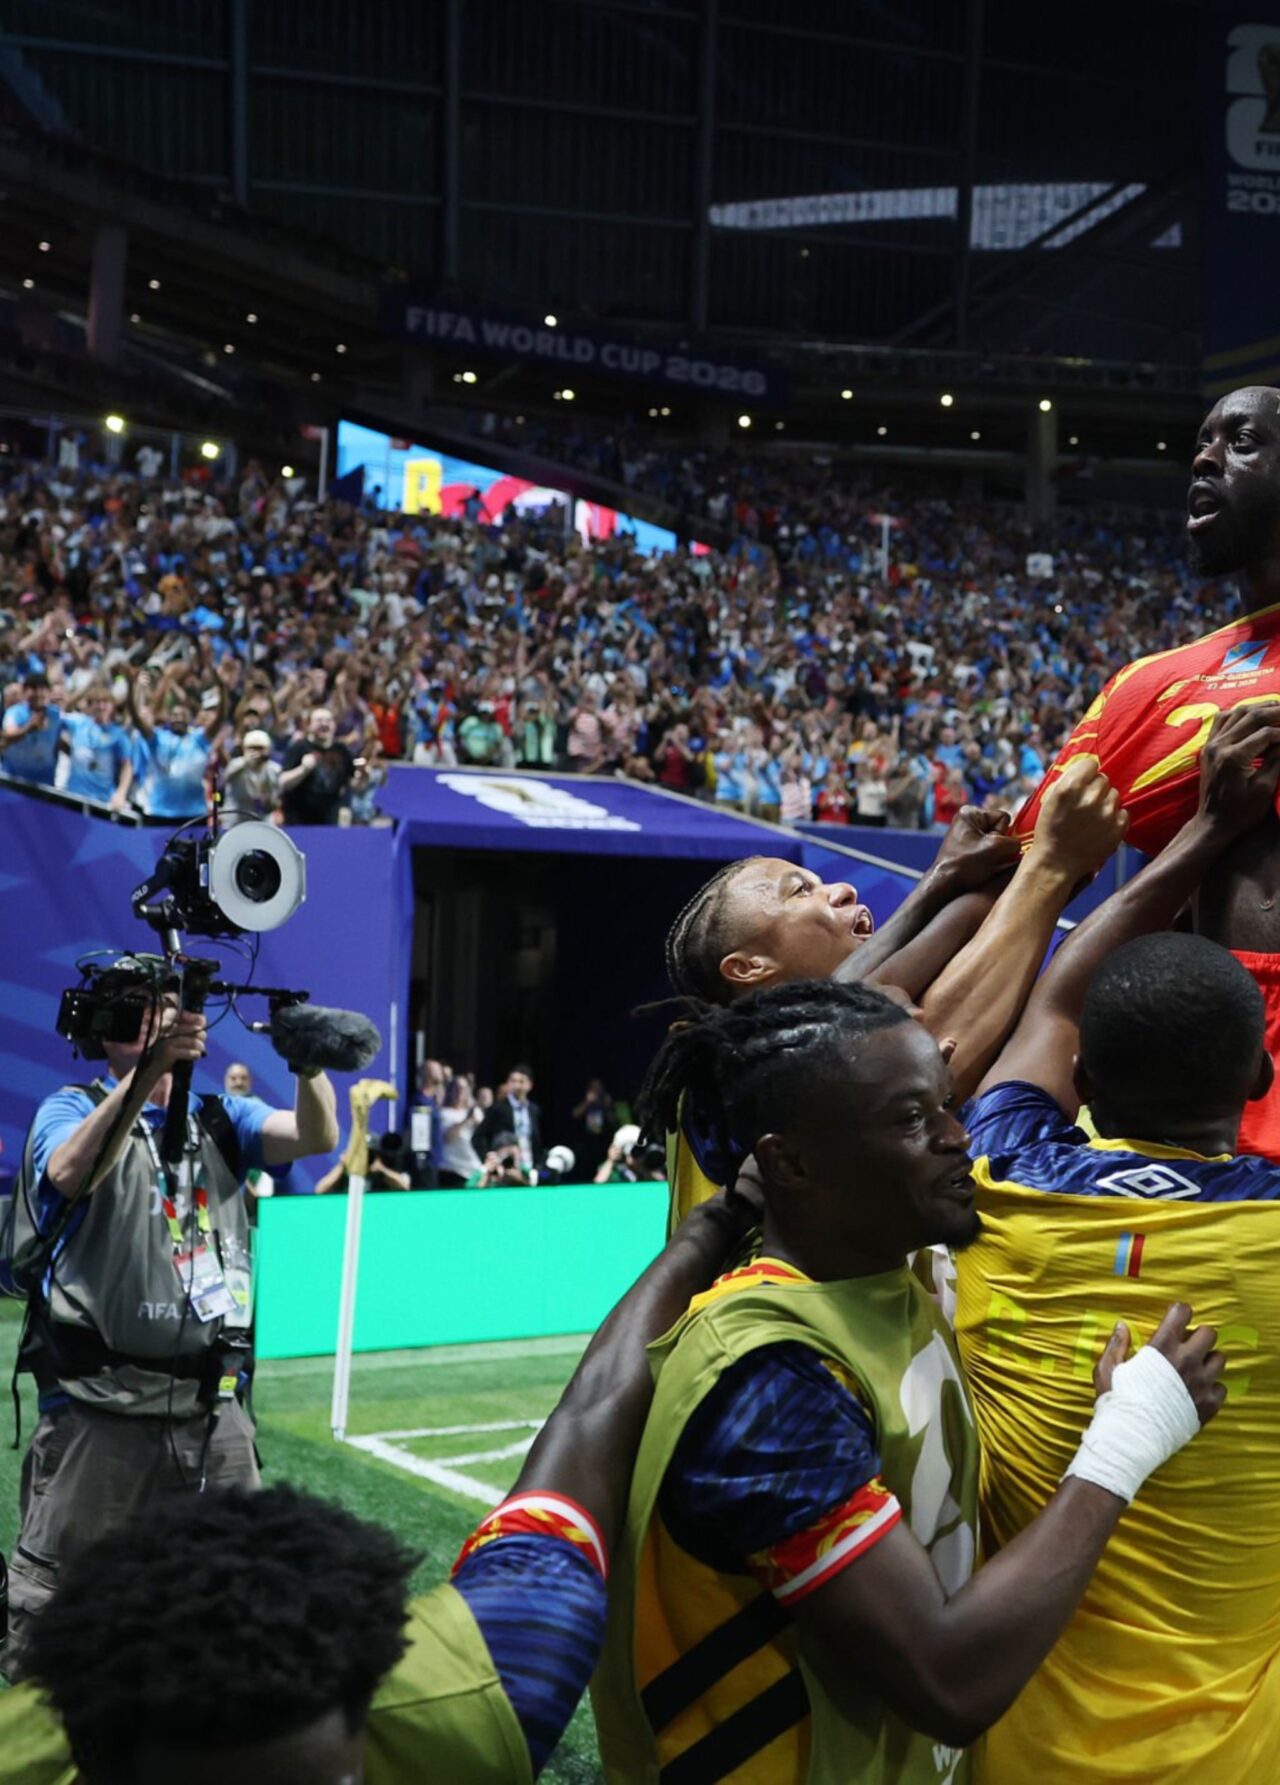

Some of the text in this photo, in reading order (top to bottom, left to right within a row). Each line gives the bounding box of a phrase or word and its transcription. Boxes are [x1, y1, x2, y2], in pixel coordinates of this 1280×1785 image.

[405, 306, 768, 397] FIFA WORLD CUP 2026
